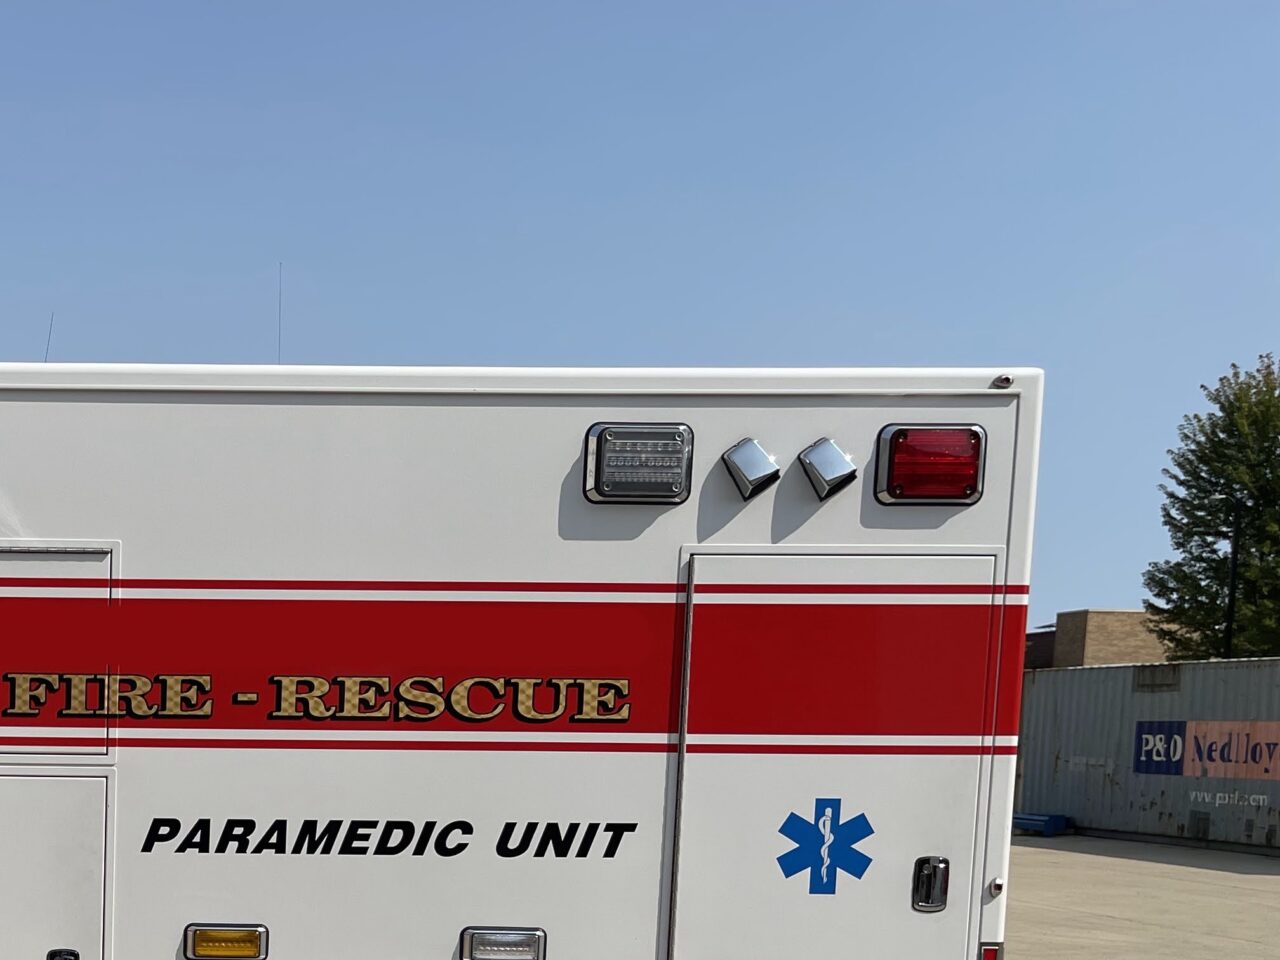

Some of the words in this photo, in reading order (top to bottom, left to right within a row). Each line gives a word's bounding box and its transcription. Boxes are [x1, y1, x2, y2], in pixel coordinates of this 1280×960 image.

[1, 673, 213, 718] FIRE
[267, 676, 631, 724] RESCUE
[1140, 734, 1183, 761] P&O
[1192, 732, 1280, 773] Nedlloy
[140, 818, 474, 857] PARAMEDIC
[495, 821, 638, 858] UNIT
